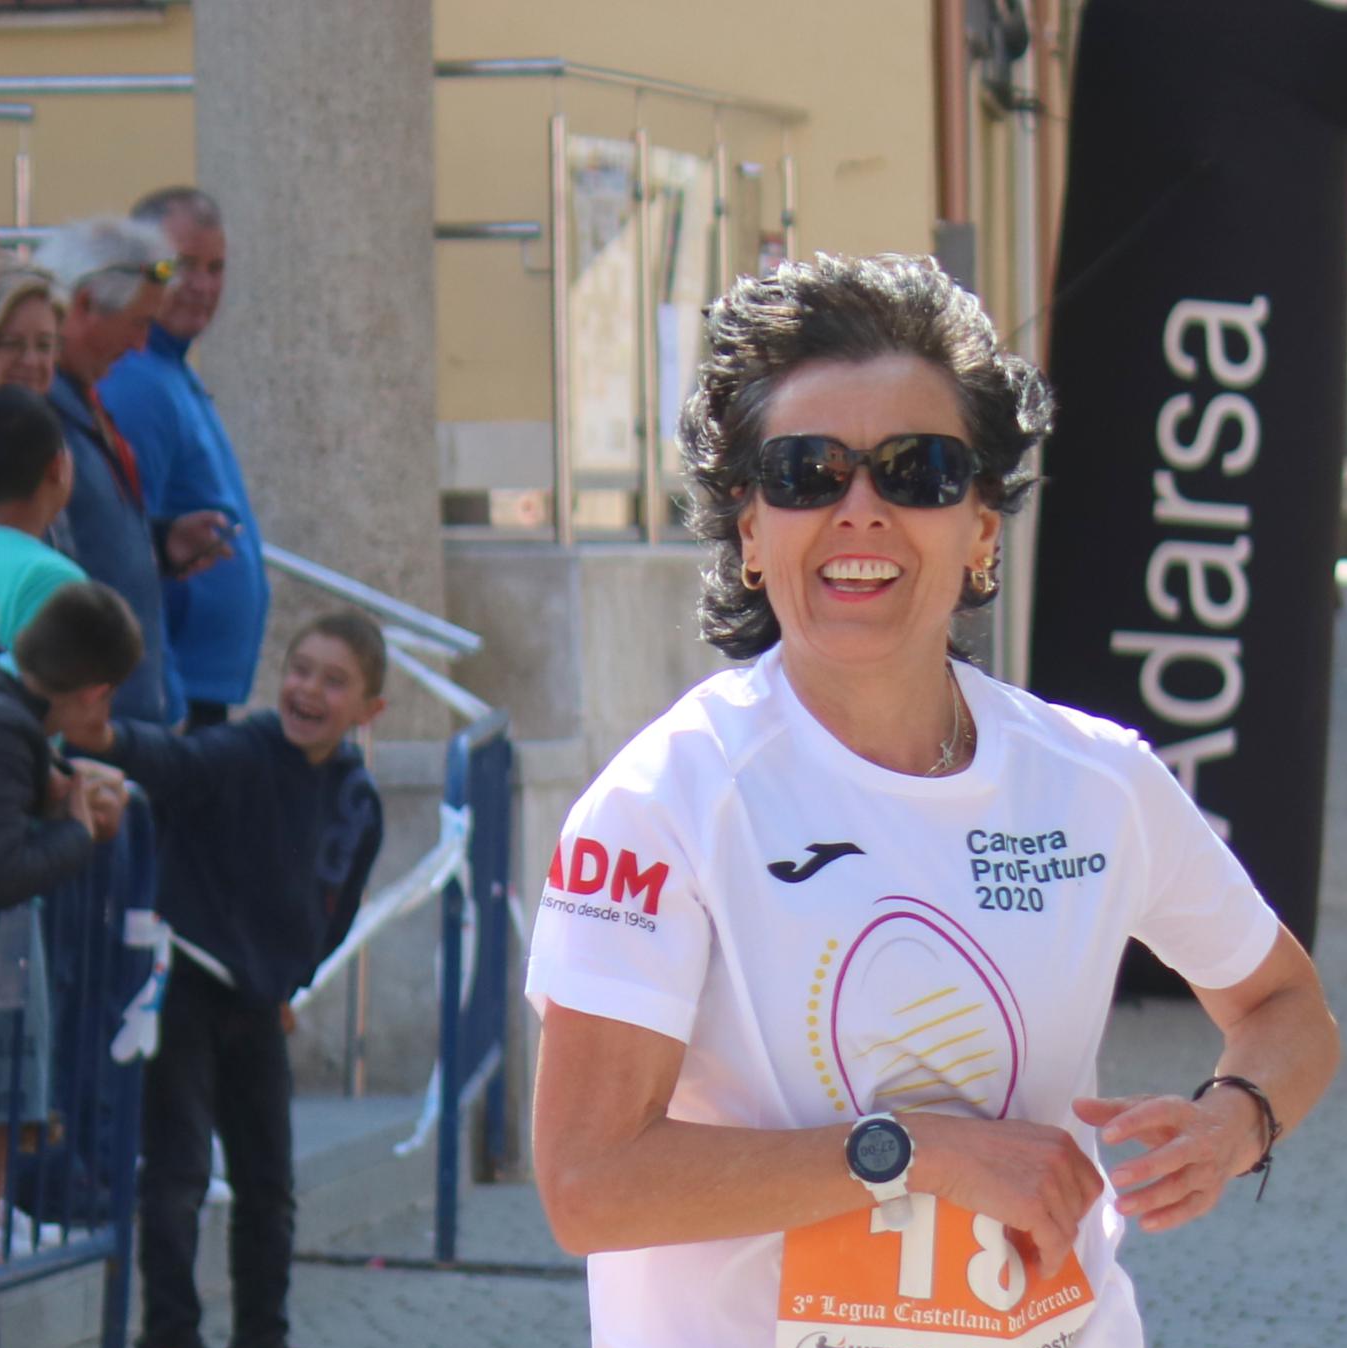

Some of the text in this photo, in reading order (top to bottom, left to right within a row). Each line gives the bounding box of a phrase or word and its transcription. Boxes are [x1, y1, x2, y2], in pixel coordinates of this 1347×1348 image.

[966, 829, 1068, 855] Carrera
[970, 853, 1106, 883] ProFuturo
[975, 886, 1044, 912] 2020
[578, 902, 620, 922] desde
[624, 911, 656, 933] 1959
[870, 1191, 1027, 1312] 18
[820, 1295, 886, 1322] Legua
[894, 1302, 1001, 1331] Castellana
[1007, 1309, 1026, 1332] del
[1027, 1285, 1082, 1320] Cerrato
